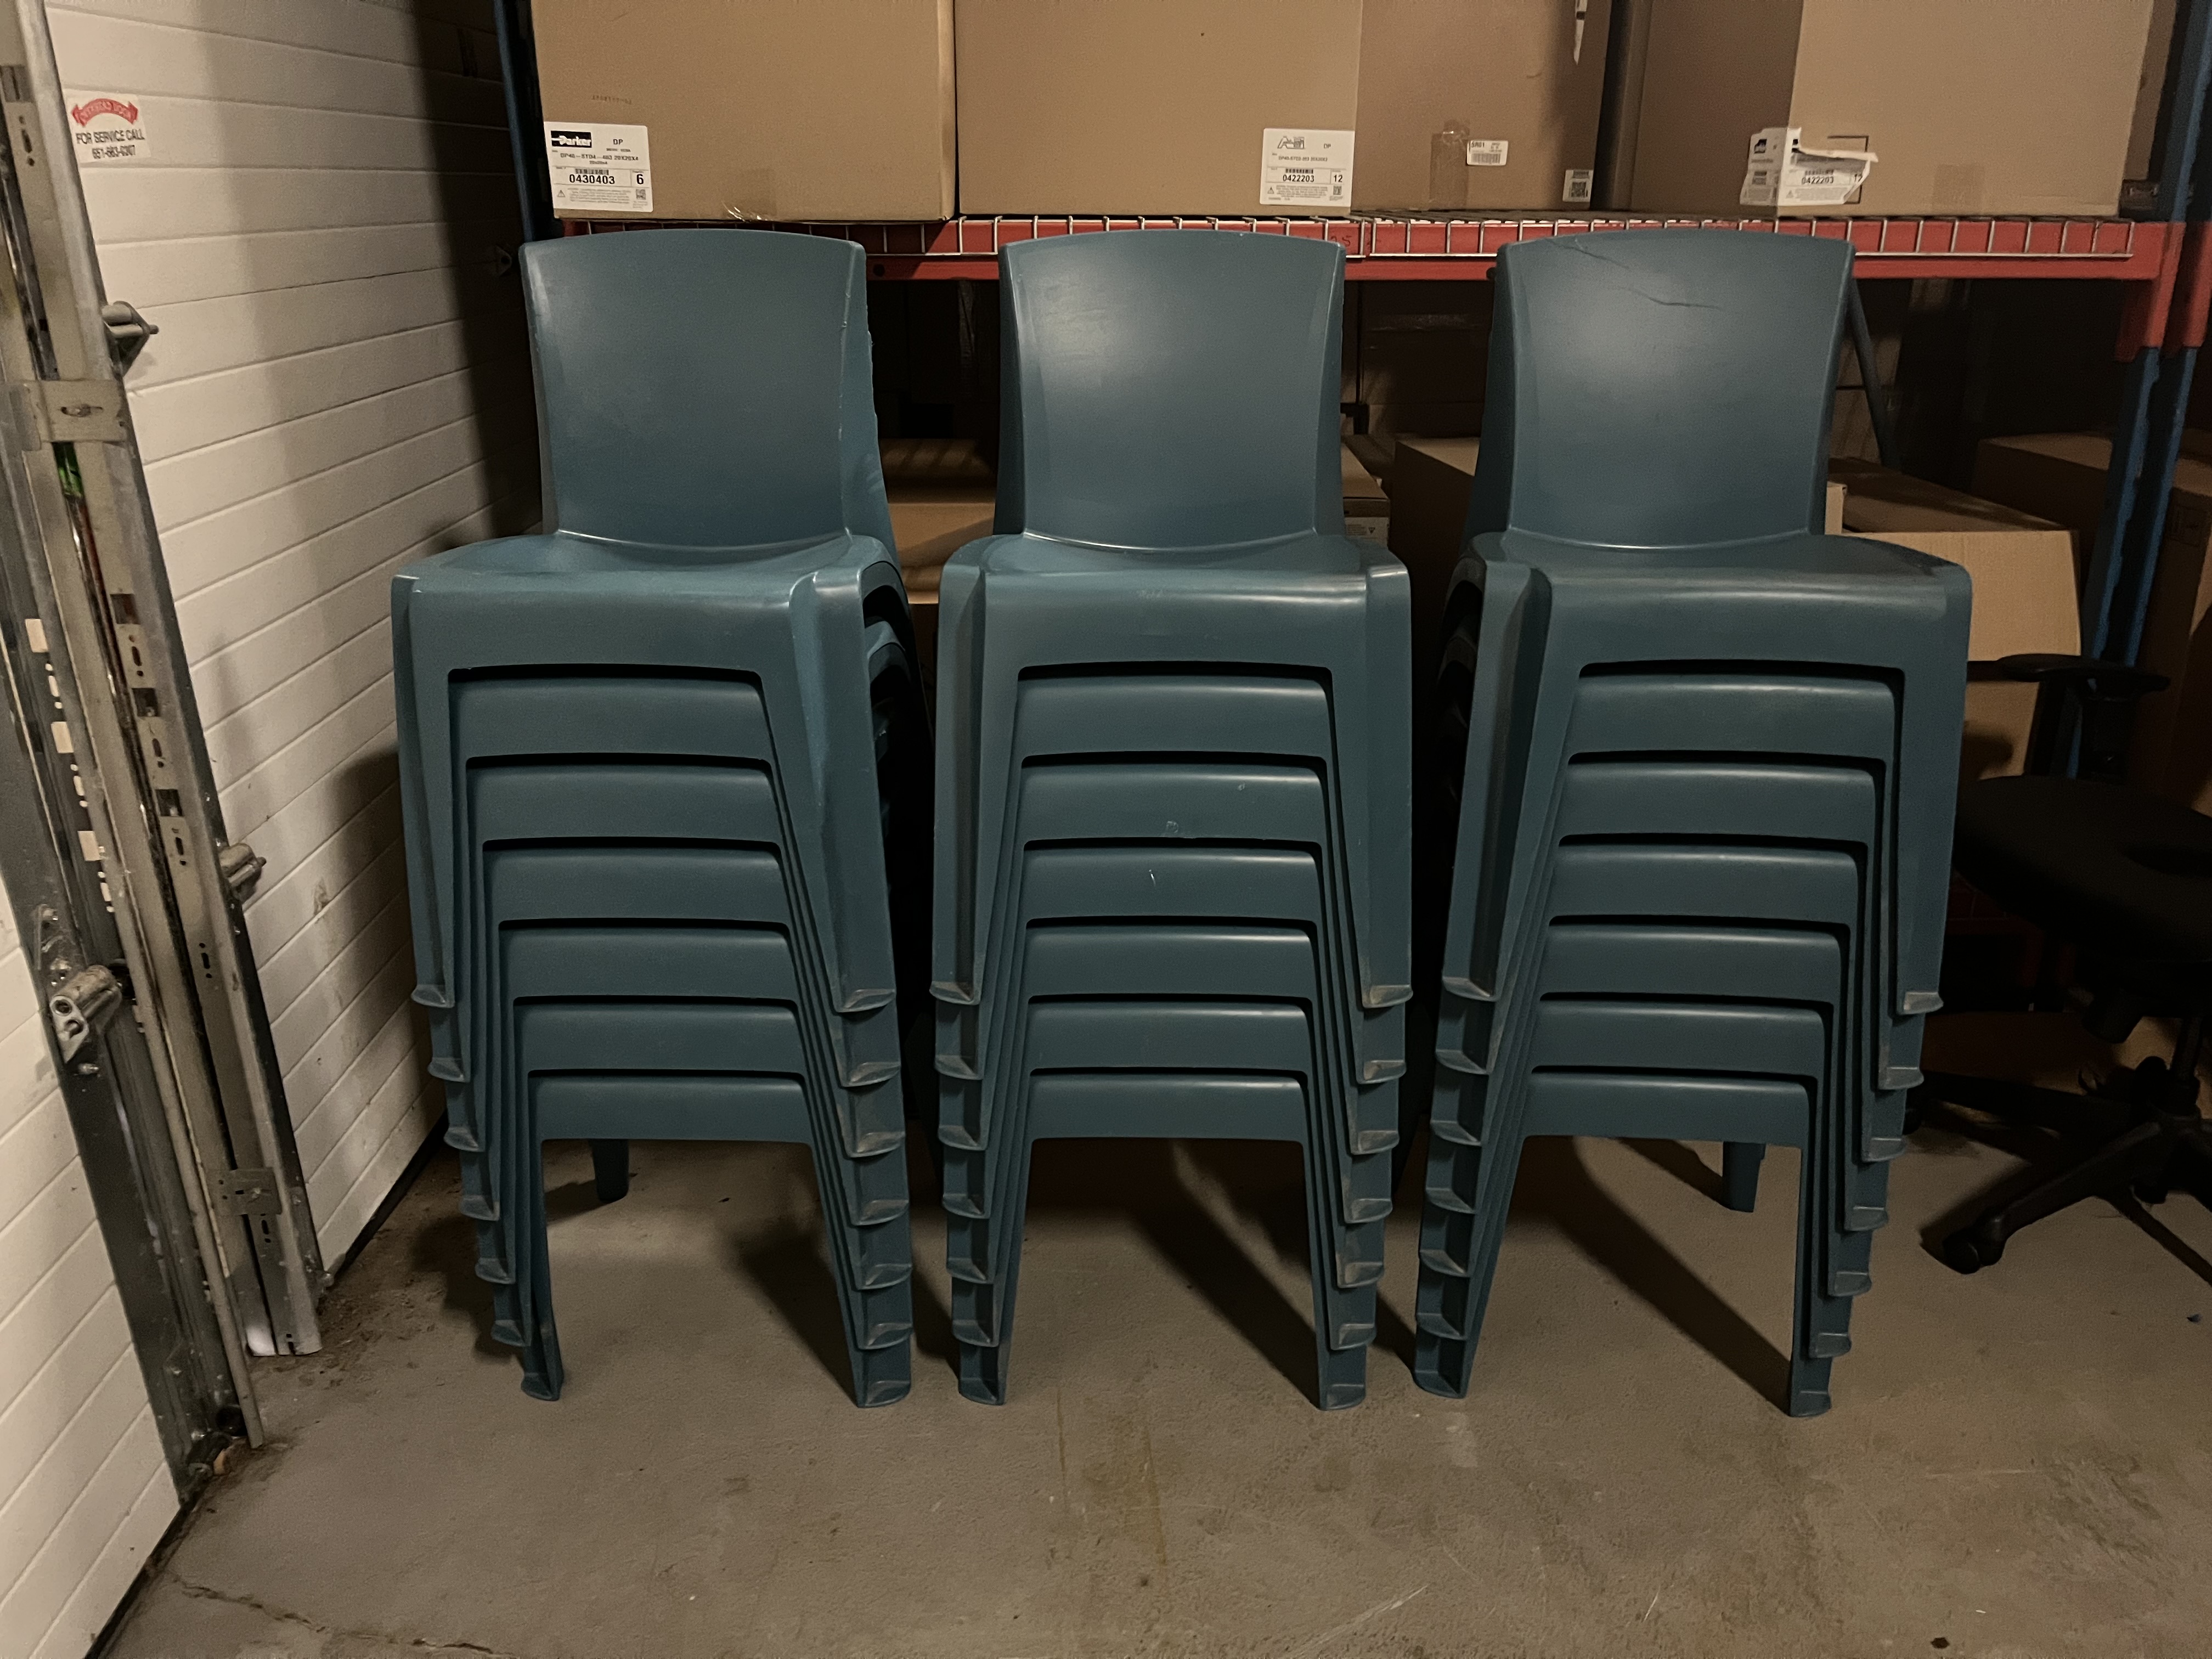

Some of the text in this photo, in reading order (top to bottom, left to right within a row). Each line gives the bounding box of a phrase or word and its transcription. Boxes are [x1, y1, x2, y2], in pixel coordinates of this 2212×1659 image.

[76, 129, 145, 144] FOR SERVICE CALL
[558, 136, 591, 146] Parker
[569, 174, 615, 184] 0430403
[636, 174, 644, 184] 6
[1333, 174, 1343, 183] 12
[1801, 177, 1834, 185] 0422203
